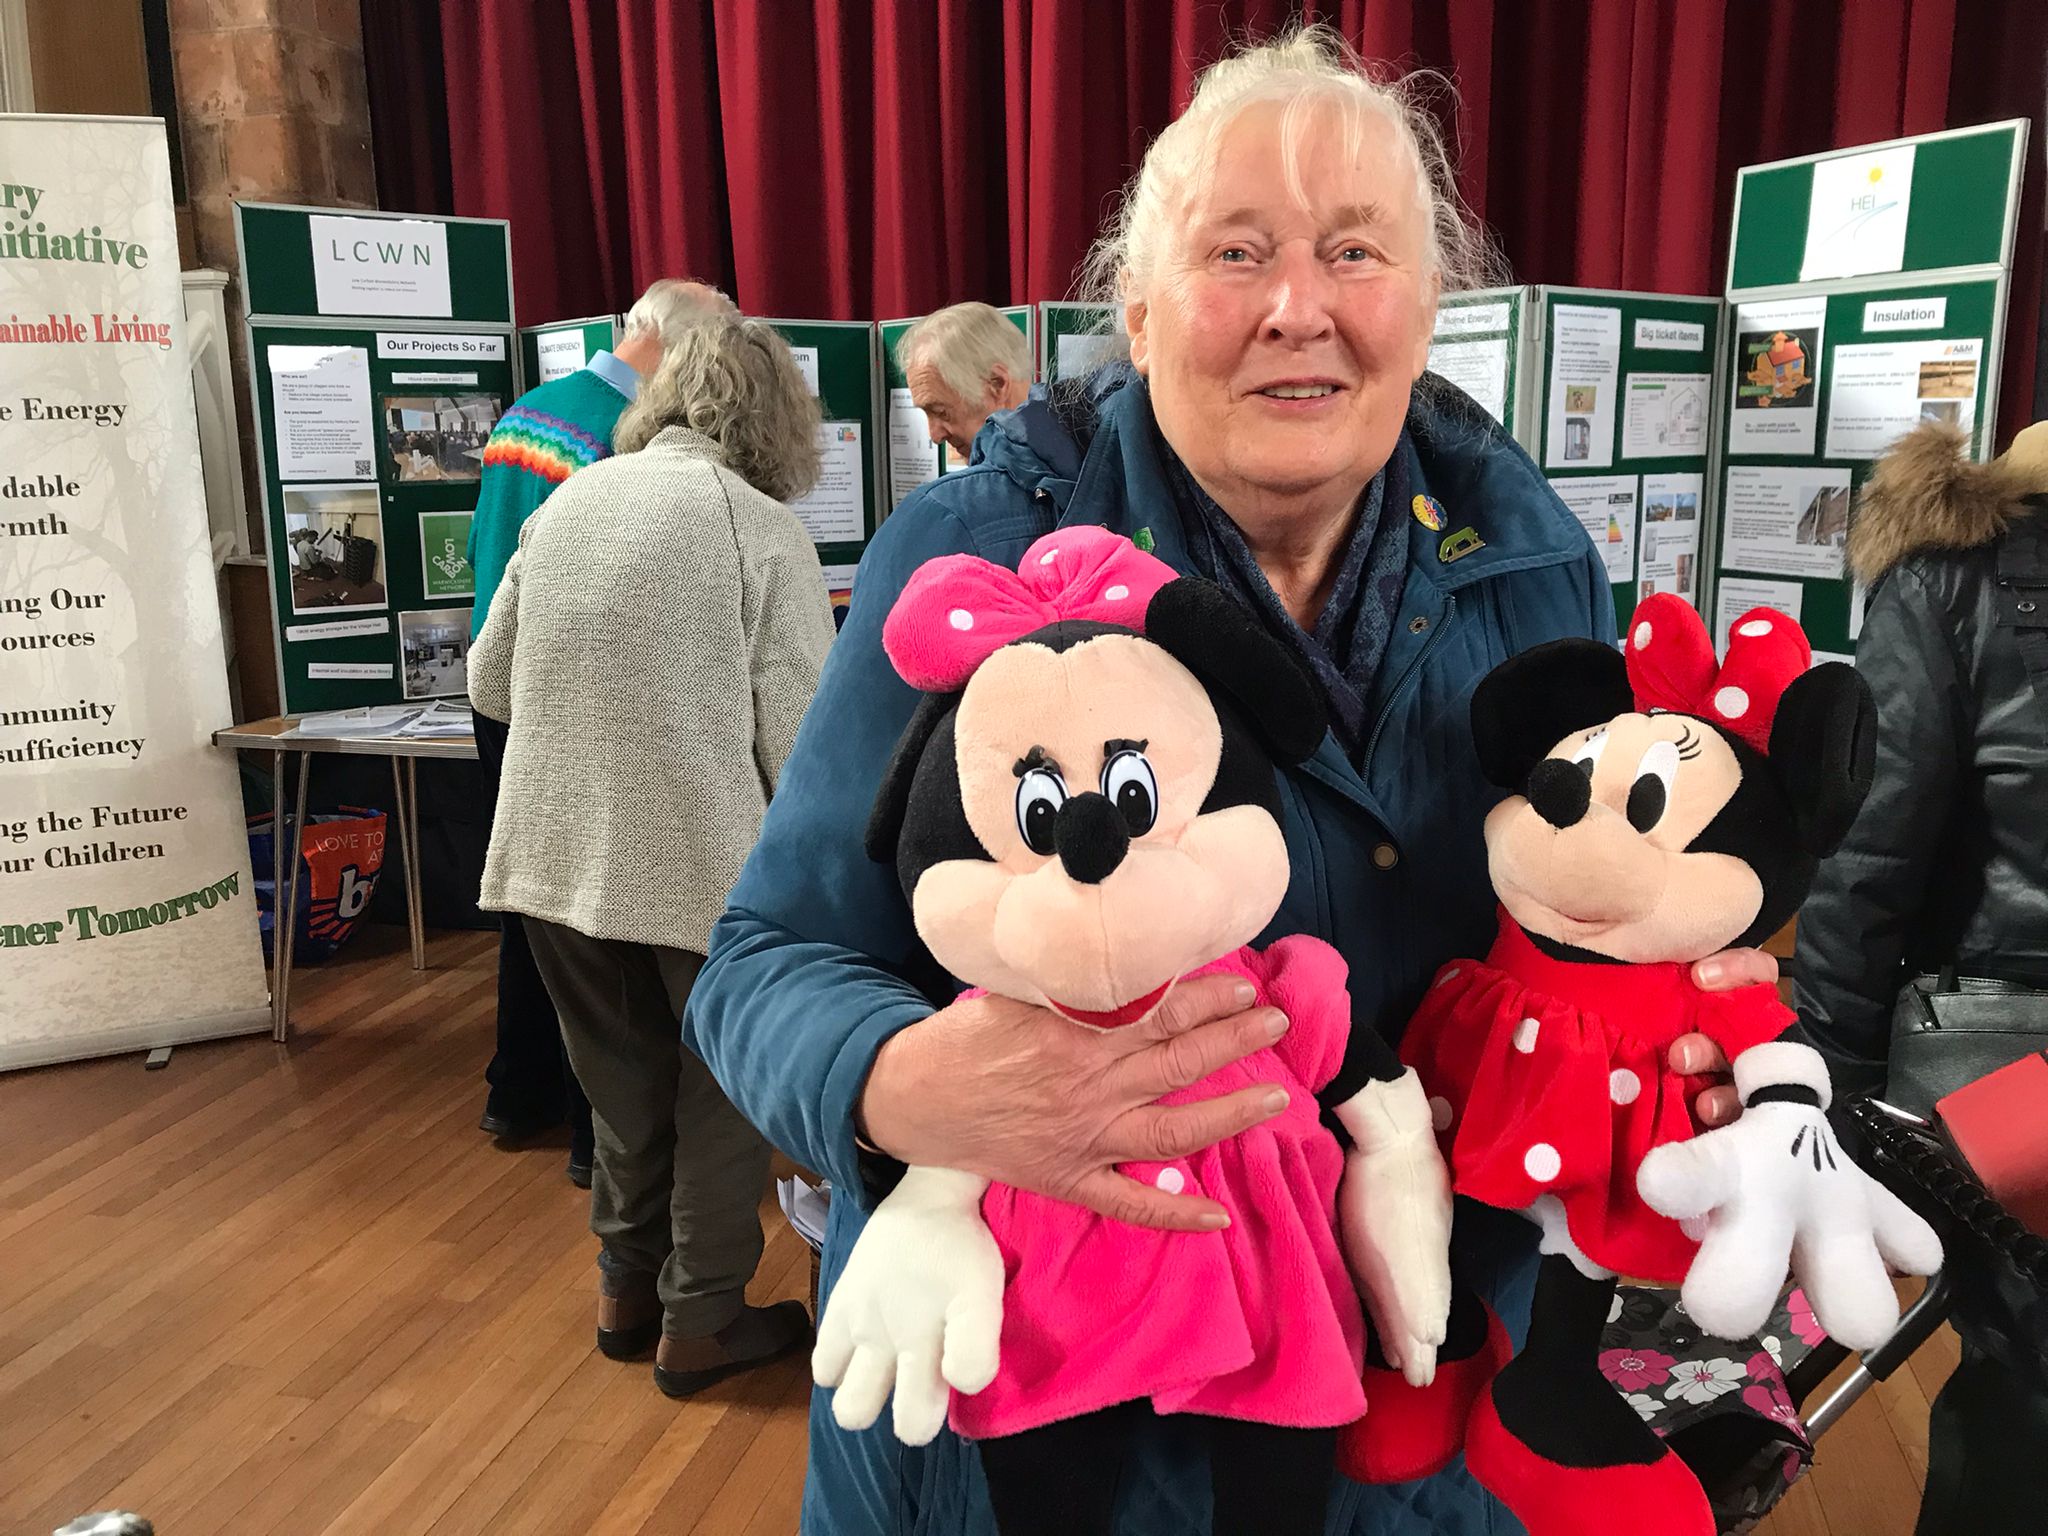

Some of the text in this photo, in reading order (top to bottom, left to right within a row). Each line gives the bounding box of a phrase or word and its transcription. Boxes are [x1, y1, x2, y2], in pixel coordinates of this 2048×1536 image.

[1851, 194, 1875, 211] HEI
[1467, 313, 1494, 324] Energy
[1873, 308, 1936, 322] Insulation
[91, 314, 173, 350] Living
[1641, 326, 1699, 341] Big ticket items
[387, 340, 497, 353] Our Projects So Far
[21, 398, 127, 427] Energy
[2, 475, 81, 499] dable
[444, 538, 455, 566] LOW
[432, 555, 468, 579] CARBON
[0, 588, 106, 620] ng Our
[1, 631, 96, 652] ources
[37, 811, 83, 833] the
[90, 805, 188, 829] Future
[315, 831, 384, 852] LOVE TO
[0, 841, 165, 873] ur Children
[0, 871, 240, 947] ner Tomorrow
